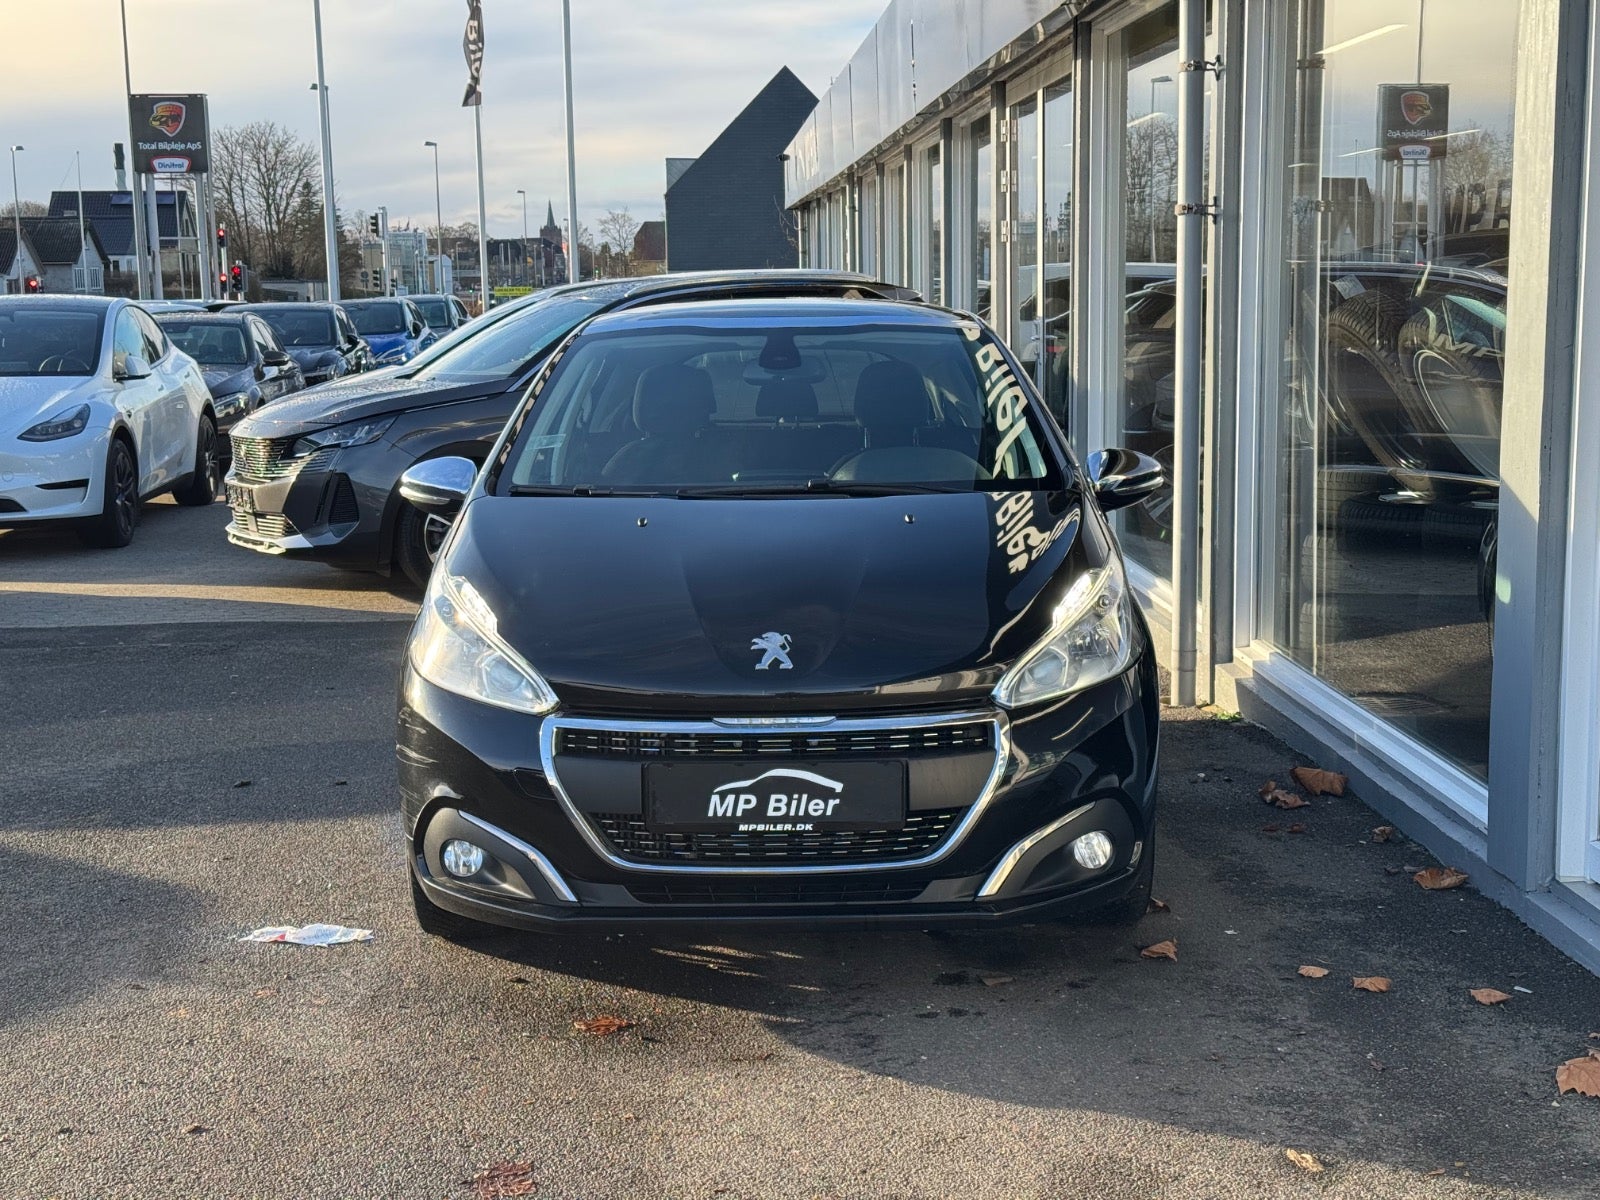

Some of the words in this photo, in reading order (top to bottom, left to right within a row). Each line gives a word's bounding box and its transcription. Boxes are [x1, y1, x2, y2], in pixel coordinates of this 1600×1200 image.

[138, 142, 157, 150] Total
[158, 141, 186, 151] Bilpleje
[187, 142, 202, 150] ApS
[707, 794, 758, 817] MP
[767, 793, 840, 817] Biler
[738, 823, 814, 831] MPBILER.DK
